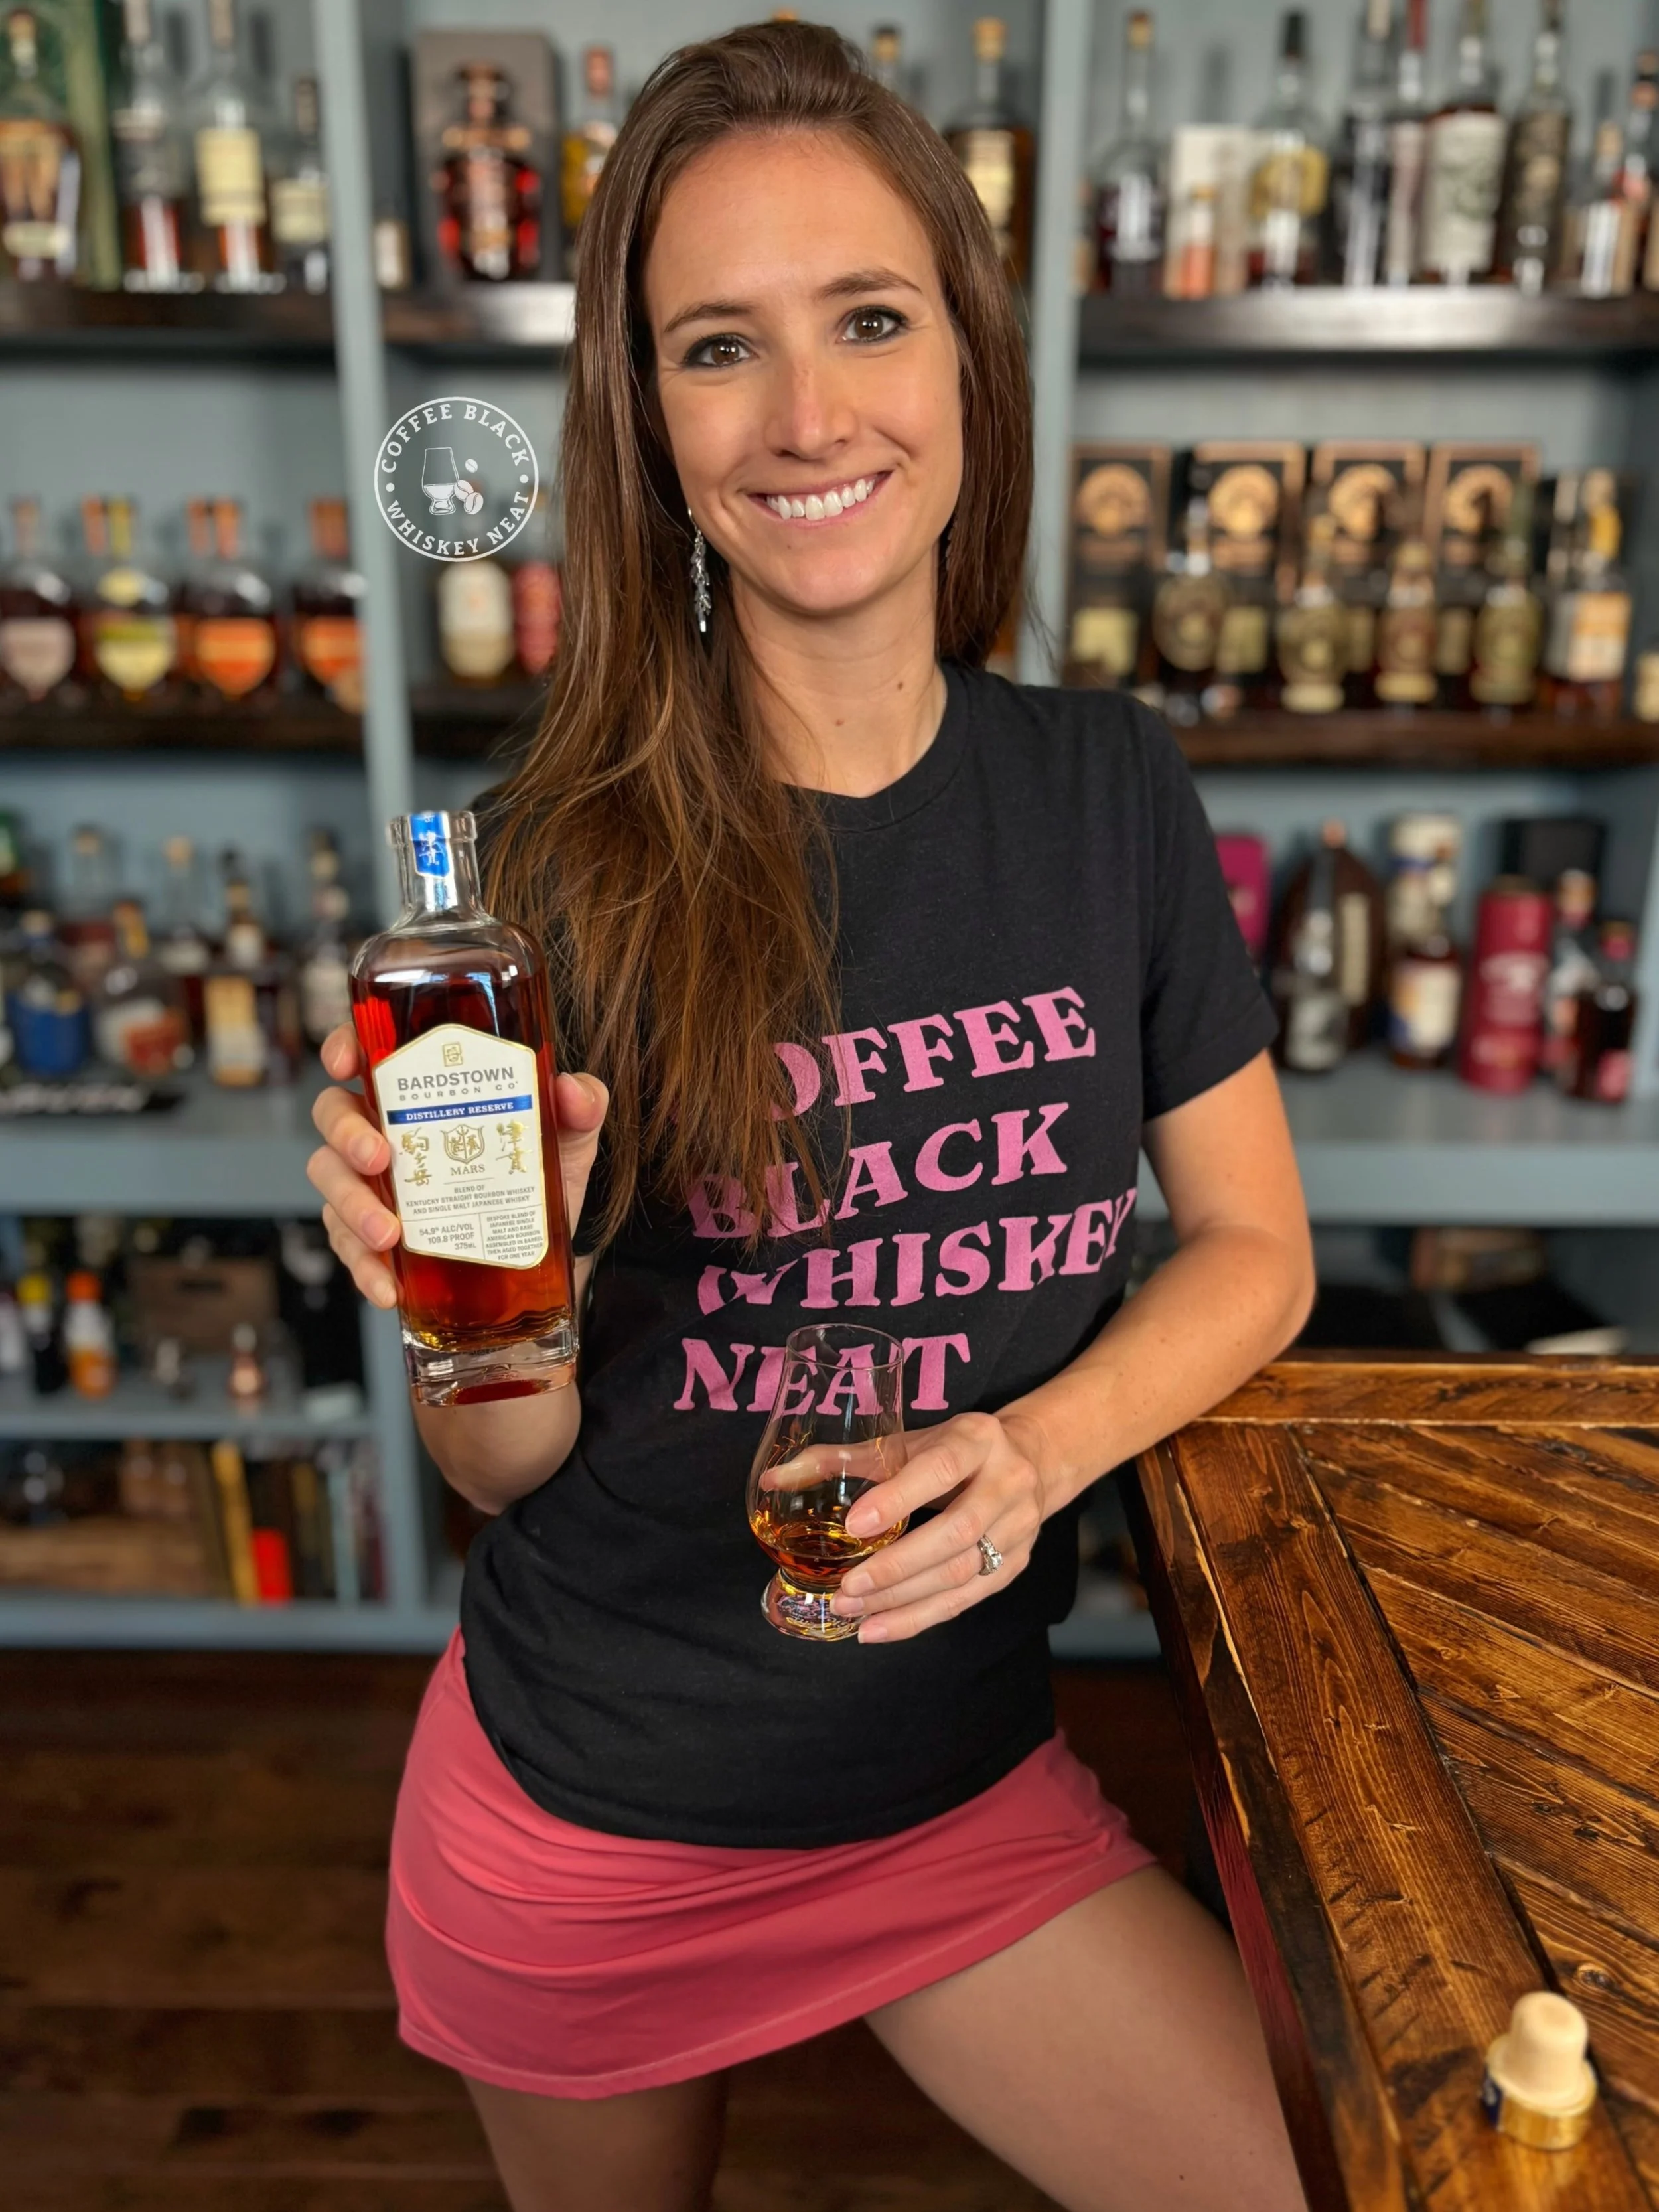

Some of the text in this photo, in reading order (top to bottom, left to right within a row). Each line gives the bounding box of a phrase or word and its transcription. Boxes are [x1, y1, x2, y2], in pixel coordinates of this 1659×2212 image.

[764, 986, 1096, 1122] OFFEE
[397, 1067, 514, 1091] BARDSTOWN
[399, 1086, 481, 1101] BOURBON
[405, 1102, 514, 1121] DISTILLERY RESERVE
[451, 1164, 486, 1176] MARS
[685, 1102, 1069, 1240] BLACK
[406, 1186, 535, 1207] KENTUCKY STRAIGHT BOURBON WHISKEY
[454, 1185, 475, 1193] BLEND
[428, 1203, 451, 1213] SINGLE
[453, 1201, 470, 1210] MALT
[472, 1199, 504, 1208] JAPANESE
[505, 1195, 530, 1204] WHISKY
[441, 1223, 474, 1233] ALC/VOL
[428, 1232, 475, 1245] 109.8 PROOF
[672, 1333, 971, 1417] NEAT
